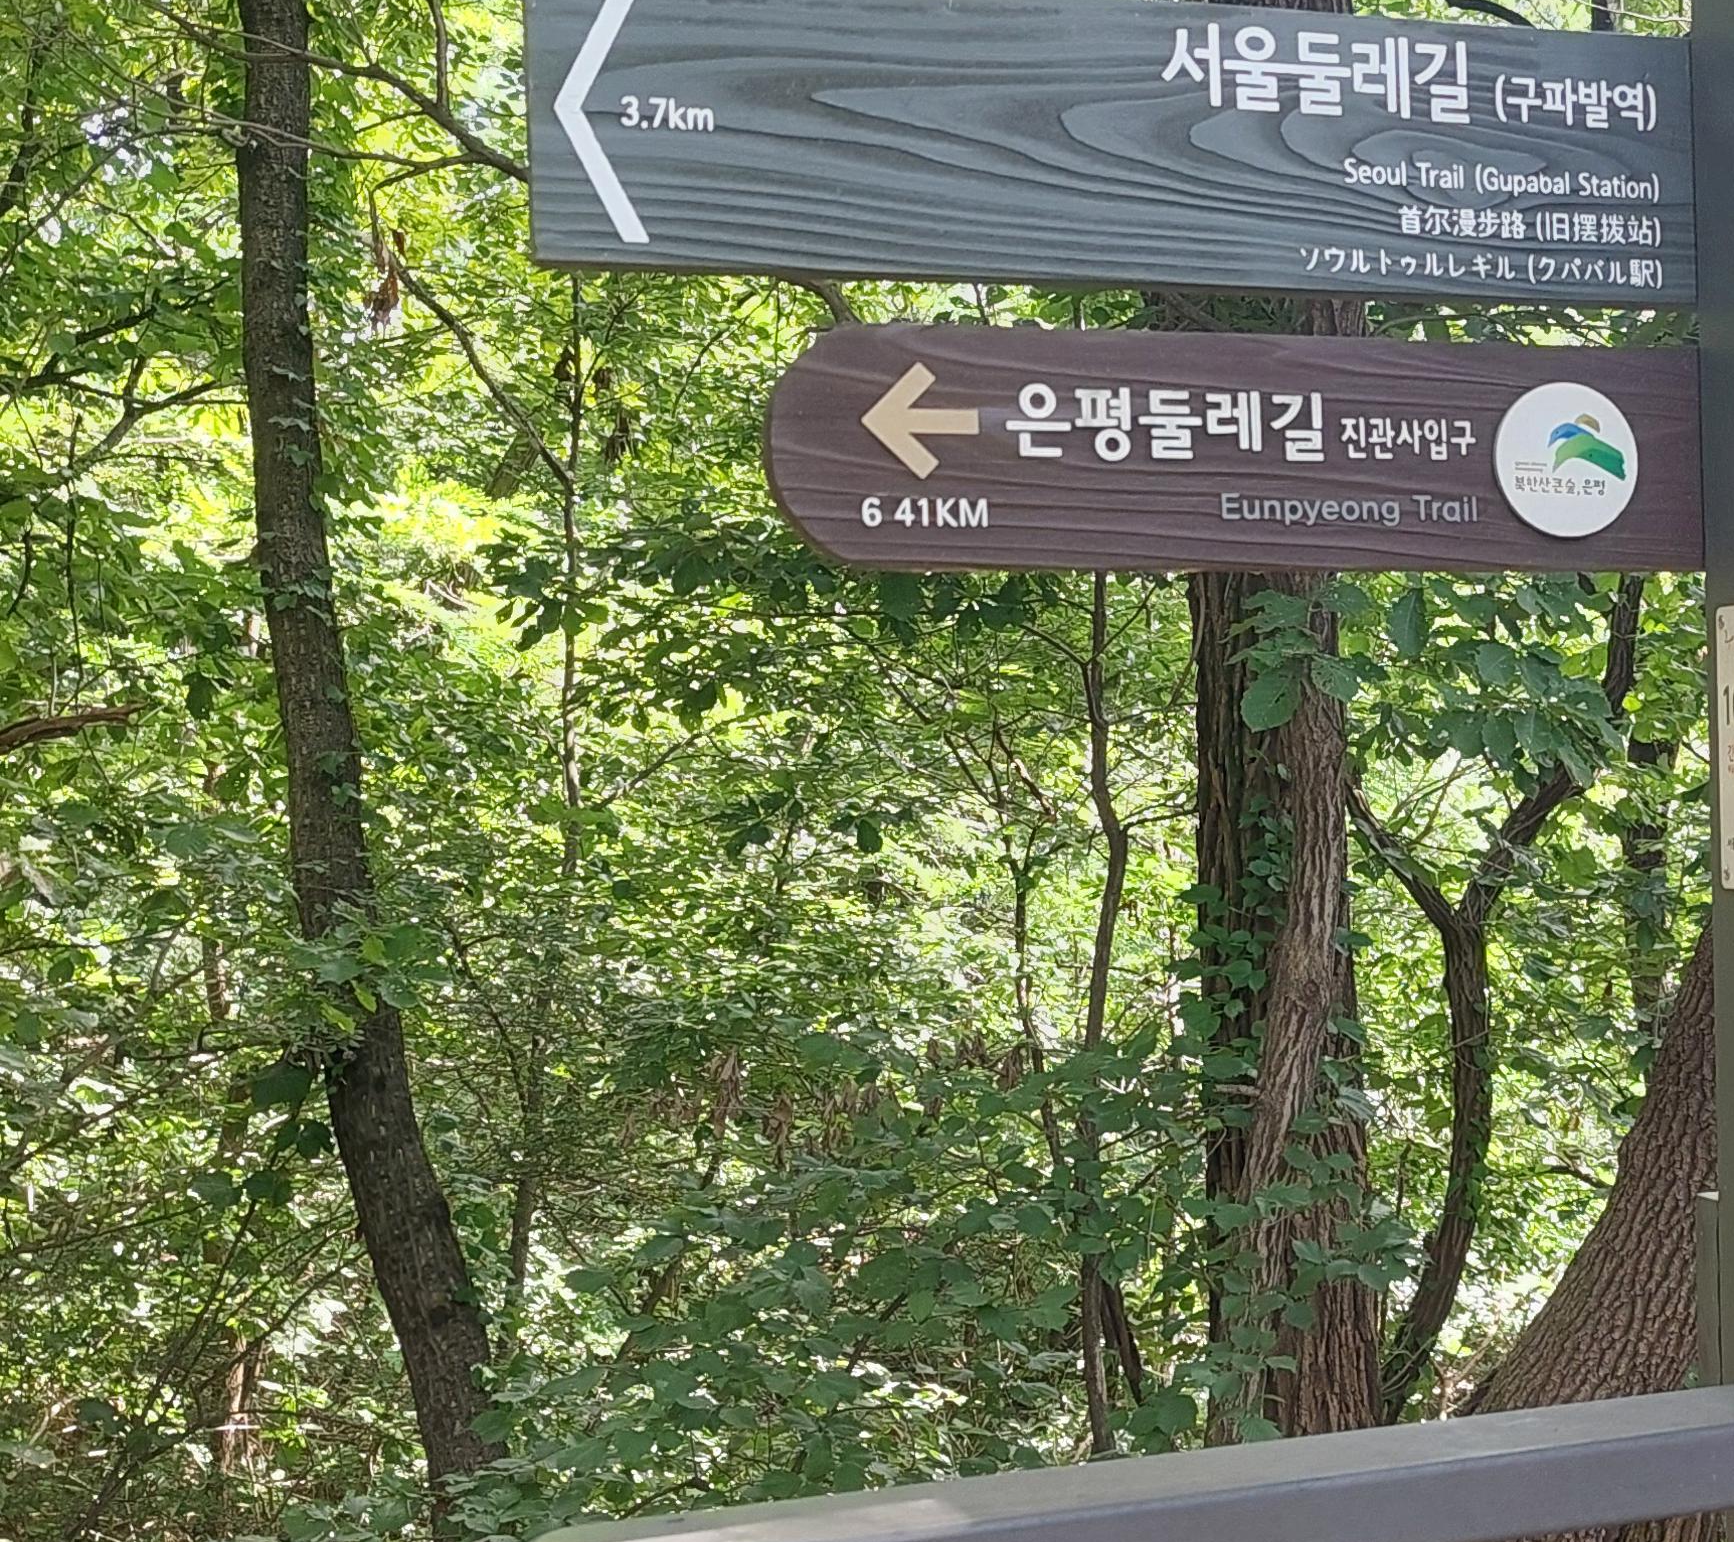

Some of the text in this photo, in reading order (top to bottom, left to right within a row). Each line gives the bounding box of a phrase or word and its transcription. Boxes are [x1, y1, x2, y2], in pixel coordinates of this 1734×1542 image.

[1161, 23, 1657, 131] 서울둘레길 (구파발역)
[620, 95, 715, 132] 3.7km
[1344, 158, 1659, 203] Seoul Trail (Gupabal Station)
[1398, 206, 1661, 247] 首尔漫步路 (旧摆拨站)
[1005, 382, 1477, 462] 은평둘레길 진관사입구
[1221, 493, 1478, 527] Eunpyeong Trail
